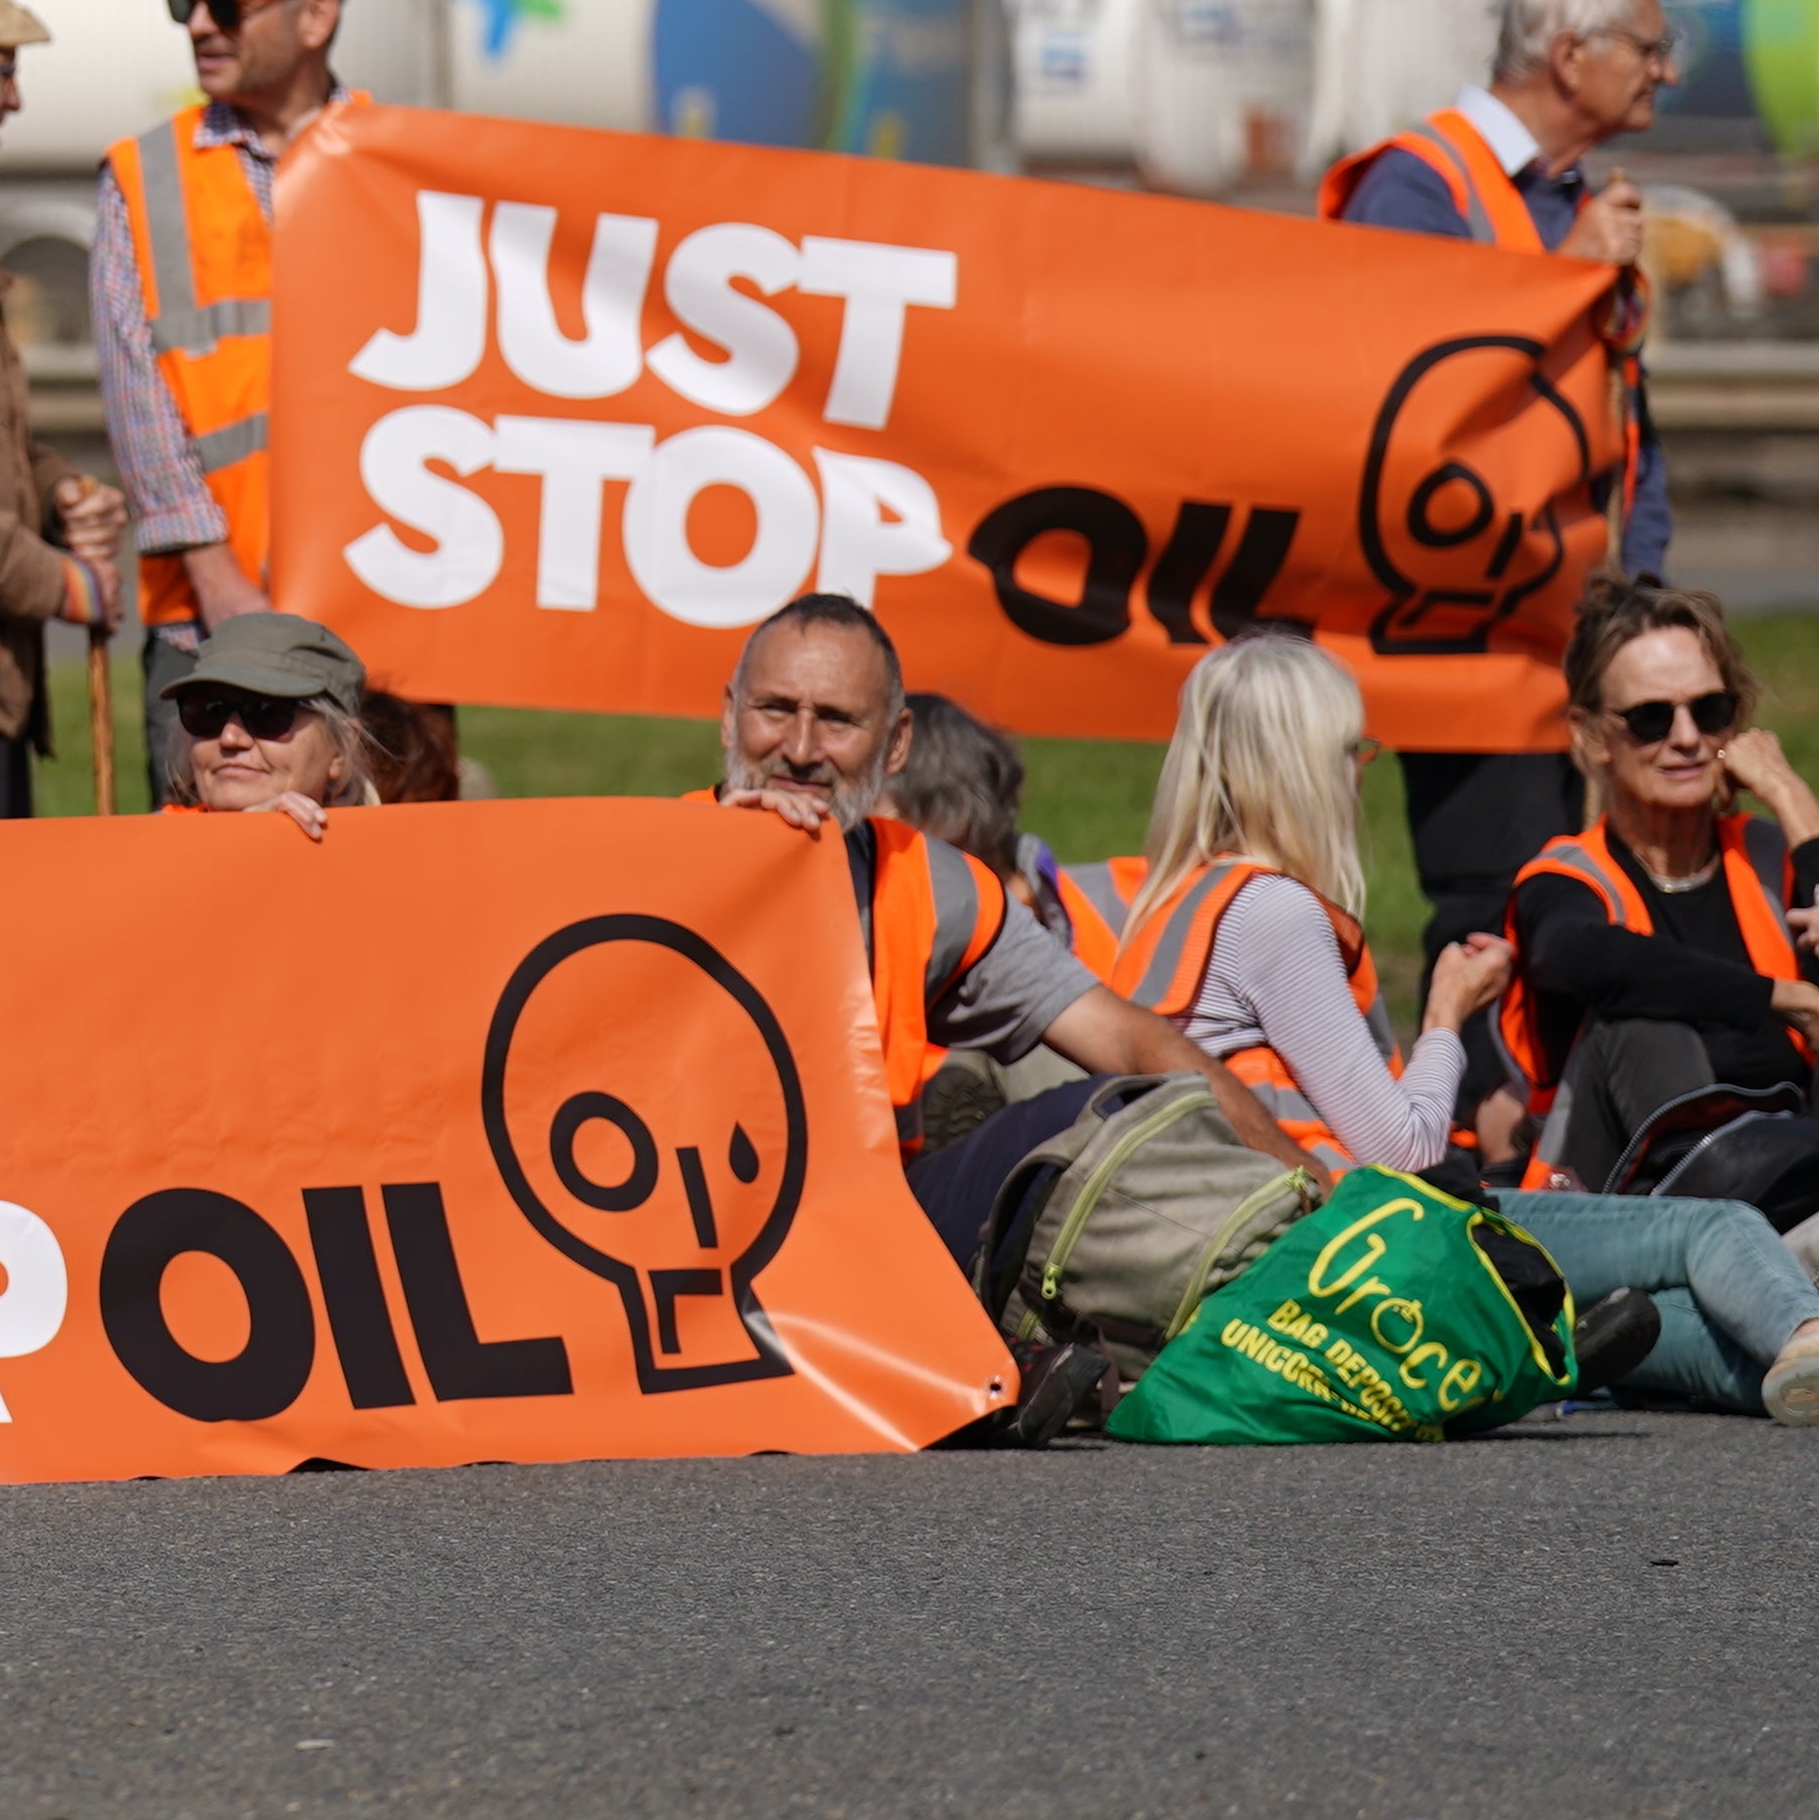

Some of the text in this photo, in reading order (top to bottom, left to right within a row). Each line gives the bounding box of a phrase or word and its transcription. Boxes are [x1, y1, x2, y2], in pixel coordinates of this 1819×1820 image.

[349, 188, 959, 430] JUST
[343, 404, 1319, 648] STOP OIL
[100, 1182, 574, 1423] OIL
[1266, 1298, 1330, 1349] BAG
[1308, 1197, 1483, 1411] Groce
